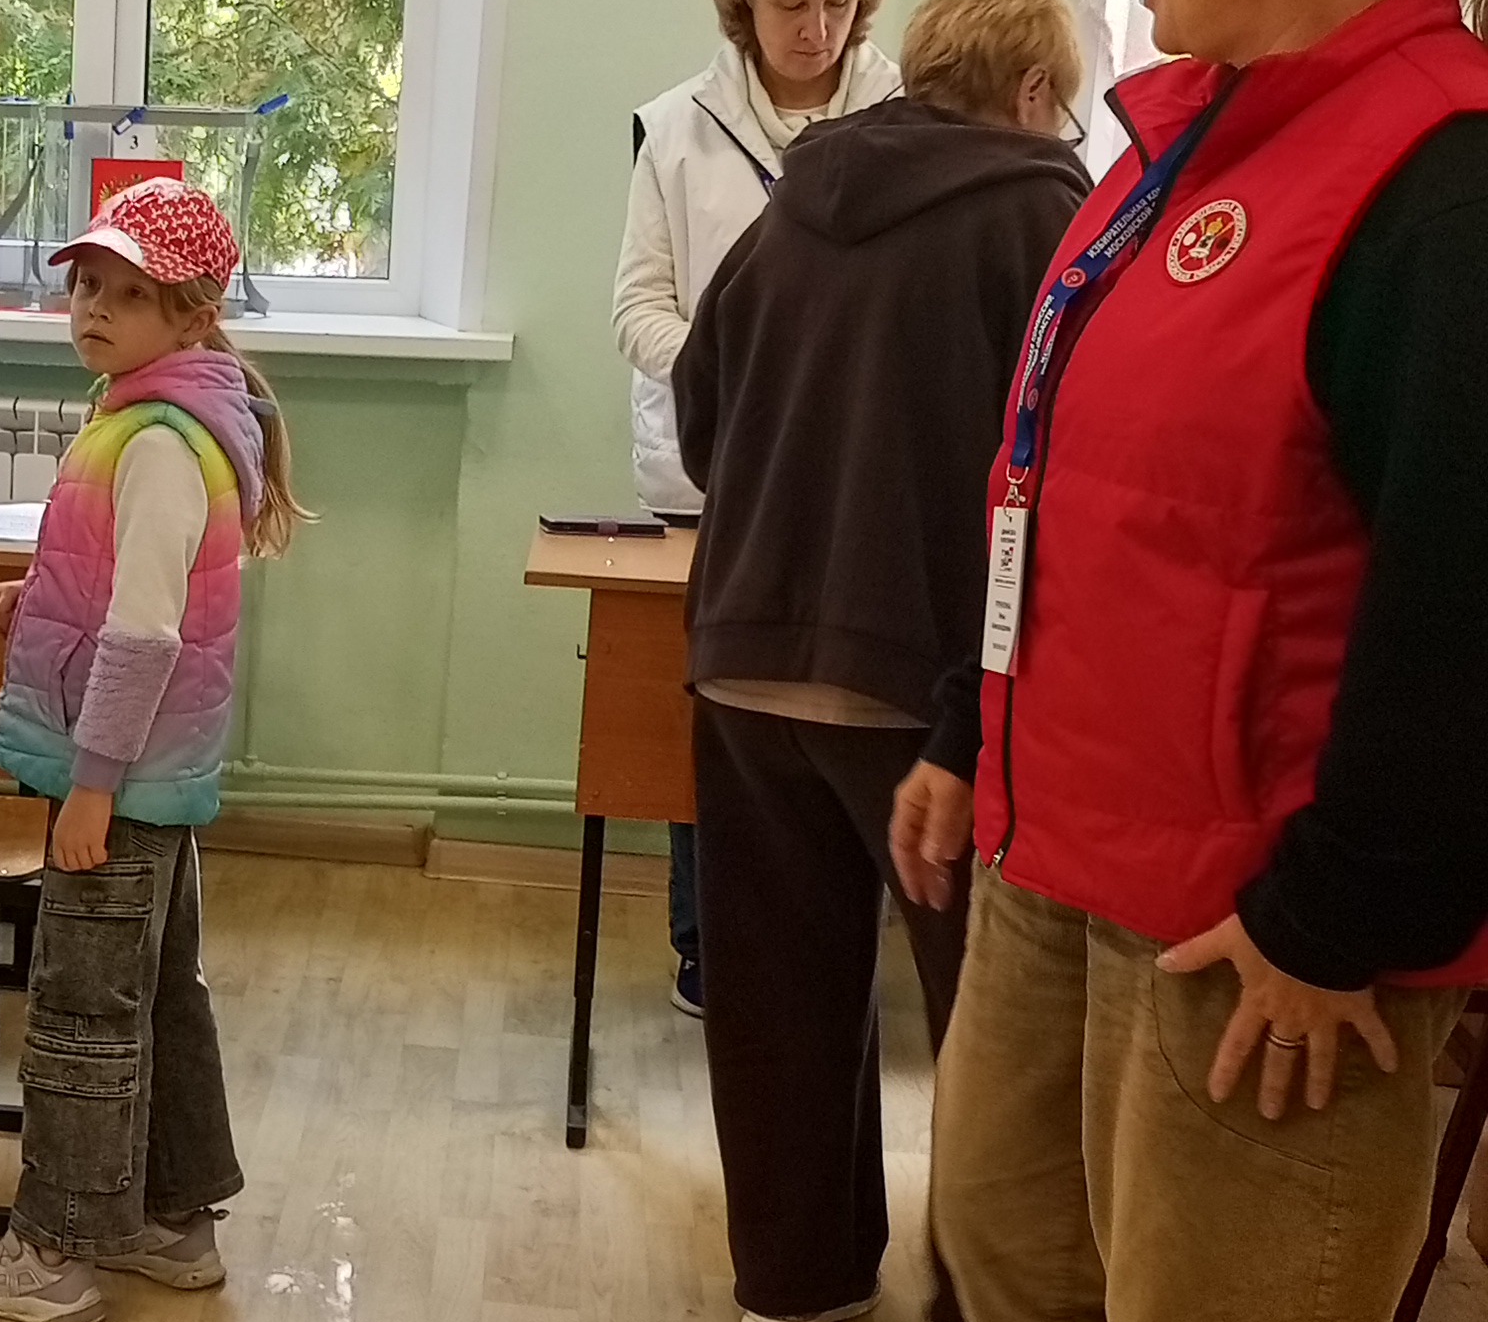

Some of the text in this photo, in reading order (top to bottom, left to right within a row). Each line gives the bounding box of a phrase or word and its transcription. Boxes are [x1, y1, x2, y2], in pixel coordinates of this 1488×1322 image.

[129, 135, 139, 150] 3
[1086, 198, 1148, 259] ИЗБИРАТЕЛЬНАЯ
[1103, 207, 1154, 258] МОСКОВСКОЙ
